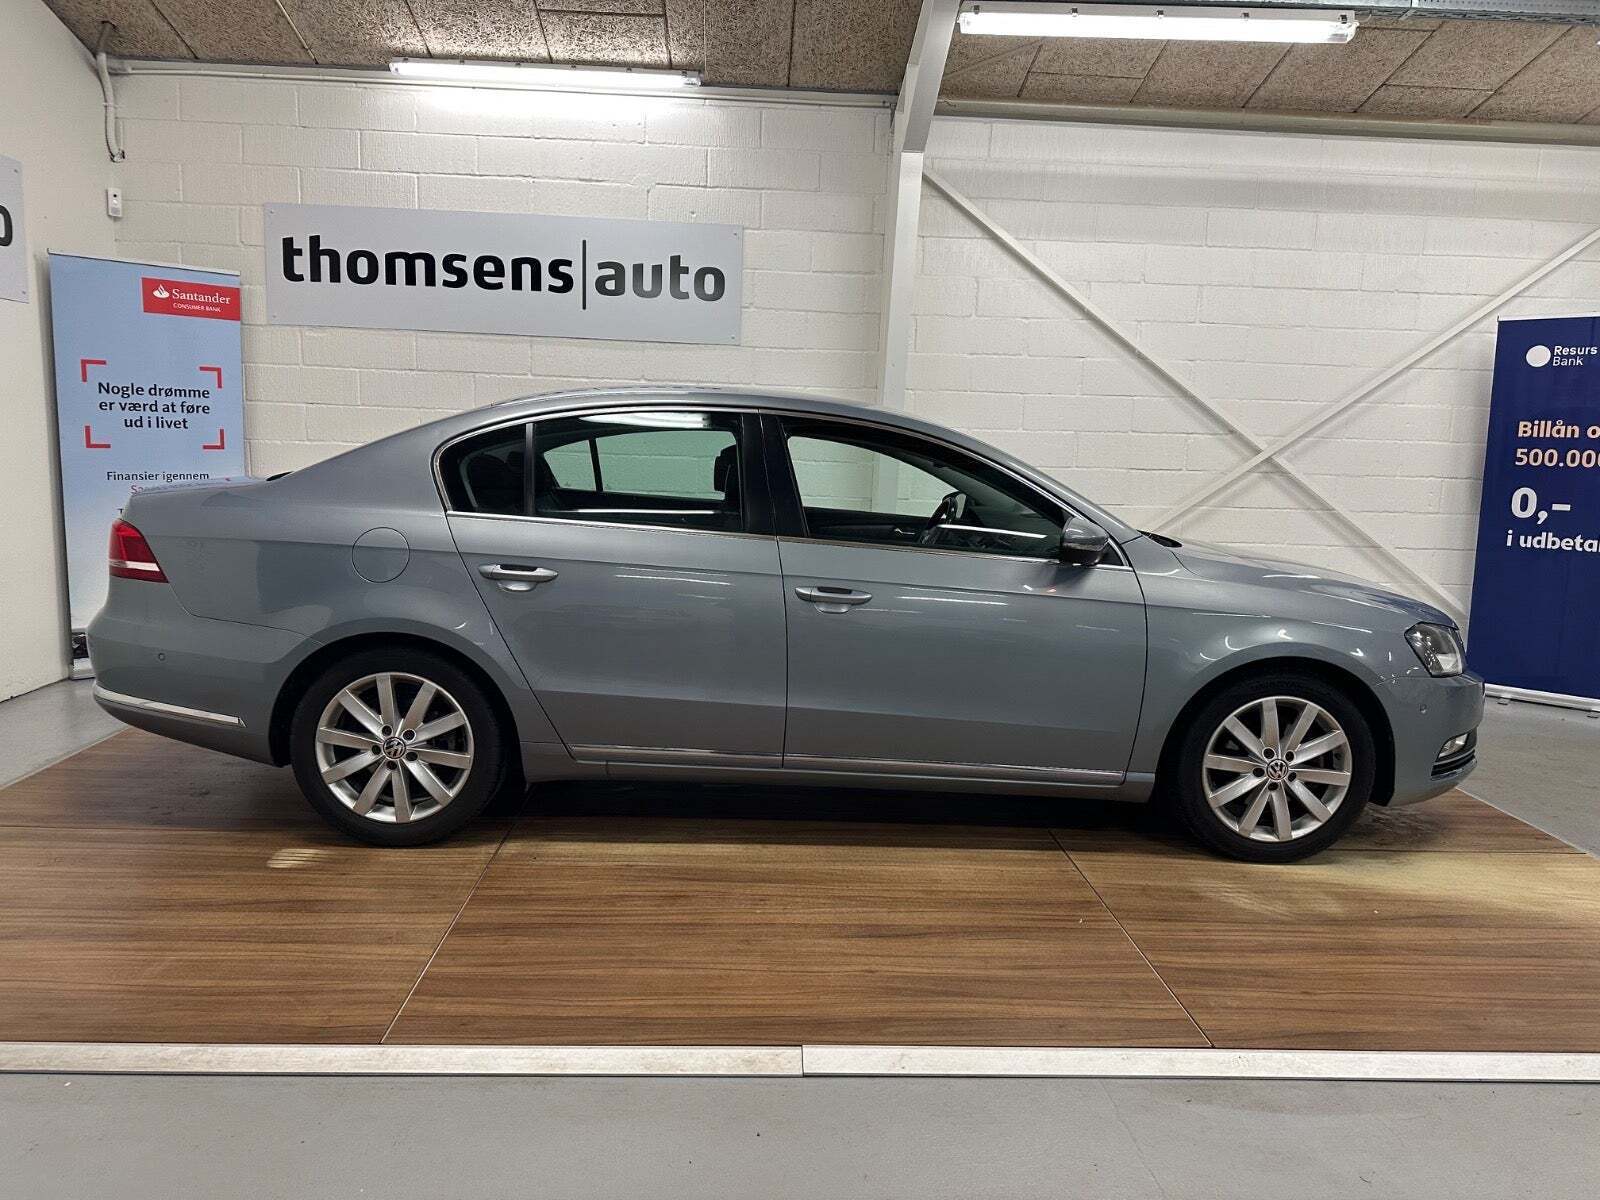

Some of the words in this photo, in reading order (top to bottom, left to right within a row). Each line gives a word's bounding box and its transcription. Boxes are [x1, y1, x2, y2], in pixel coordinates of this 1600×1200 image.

[281, 234, 574, 294] thomsens
[594, 254, 726, 302] auto
[172, 288, 231, 304] Santander
[173, 302, 205, 311] CONSUMER
[1554, 345, 1598, 356] Resurs
[1552, 356, 1583, 366] Bank
[98, 382, 144, 398] Nogle
[148, 384, 210, 398] drømme
[99, 401, 115, 411] er
[119, 400, 158, 412] værd
[162, 401, 176, 413] at
[180, 401, 210, 414] føre
[124, 416, 143, 428] ud
[147, 416, 152, 428] i
[156, 416, 188, 429] livet
[1518, 419, 1580, 438] Billån
[1515, 448, 1600, 468] 500.00
[106, 471, 160, 481] Finansier
[162, 471, 210, 483] igennem
[1506, 529, 1513, 547] i
